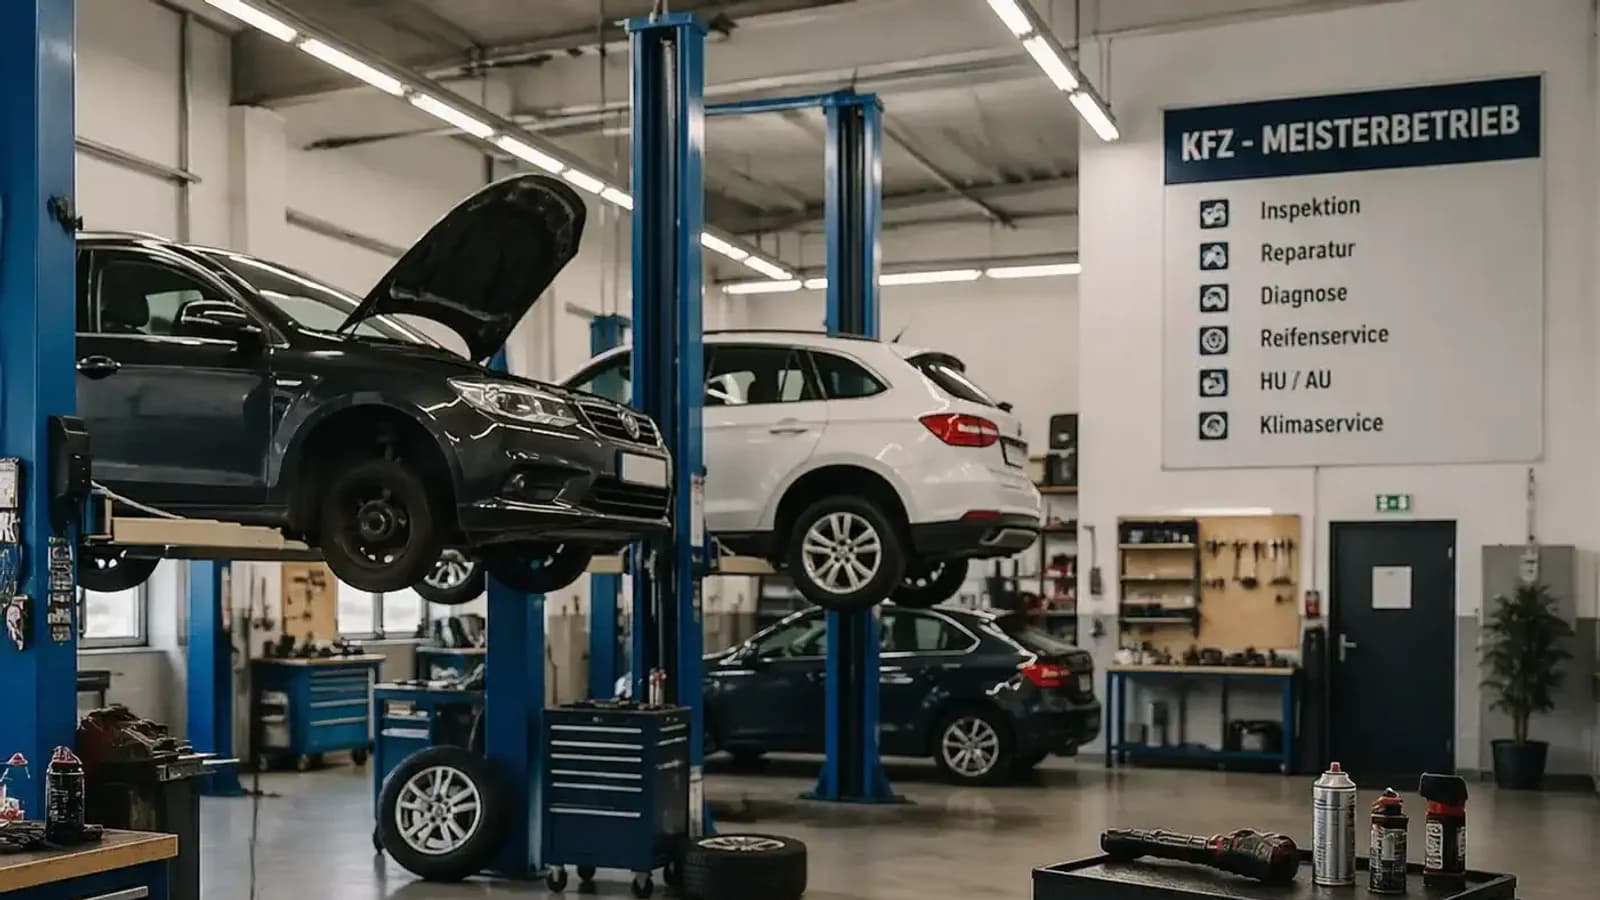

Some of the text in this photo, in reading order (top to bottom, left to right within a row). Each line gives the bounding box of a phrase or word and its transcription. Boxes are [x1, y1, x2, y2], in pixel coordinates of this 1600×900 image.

[1181, 128, 1235, 162] KFZ
[1262, 103, 1521, 155] MEISTERBETRIEB
[1260, 195, 1361, 223] Inspektion
[1260, 240, 1357, 265] Reparatur
[1260, 284, 1348, 308] Diagnose
[1260, 323, 1390, 348] Reifenservice
[1260, 369, 1332, 392] HU / AU
[1260, 412, 1385, 435] Klimaservice
